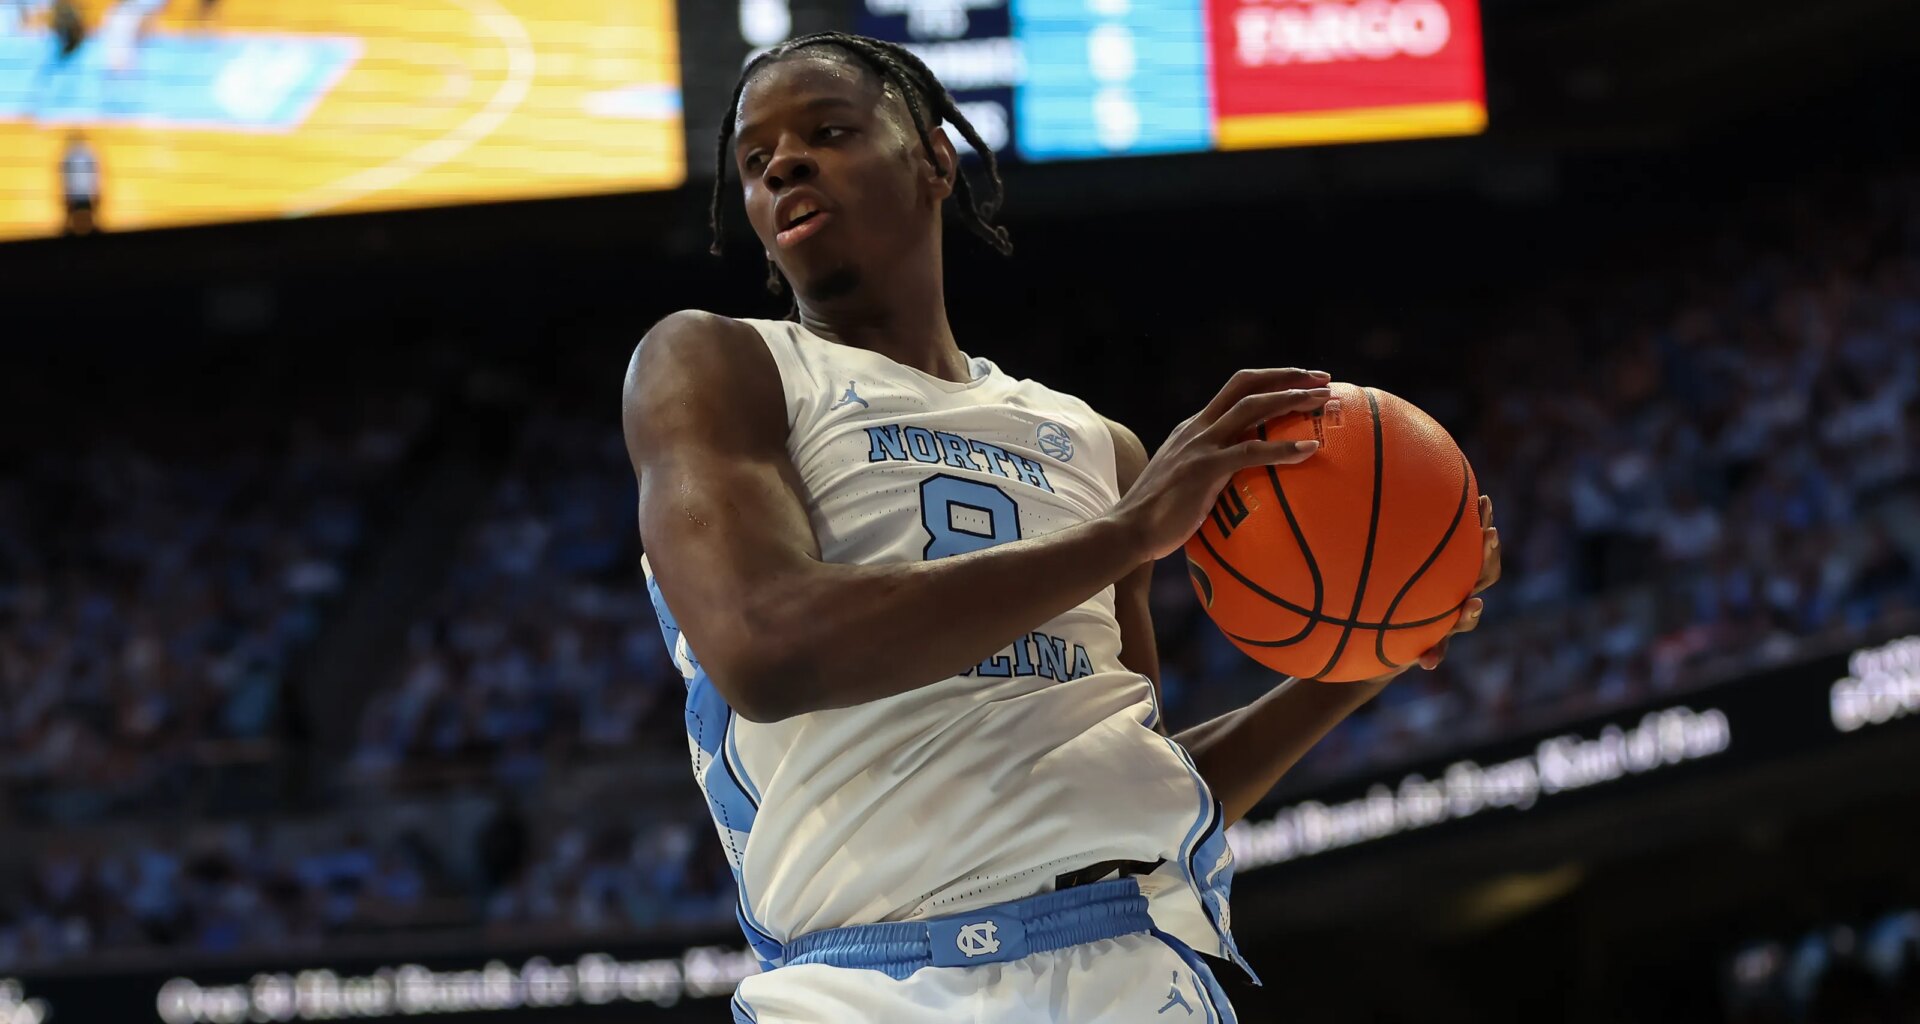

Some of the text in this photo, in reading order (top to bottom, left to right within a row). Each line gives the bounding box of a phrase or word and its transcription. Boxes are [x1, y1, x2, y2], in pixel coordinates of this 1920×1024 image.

[864, 424, 1055, 494] NORTH
[919, 472, 1021, 561] 8
[959, 631, 1094, 683] LINA
